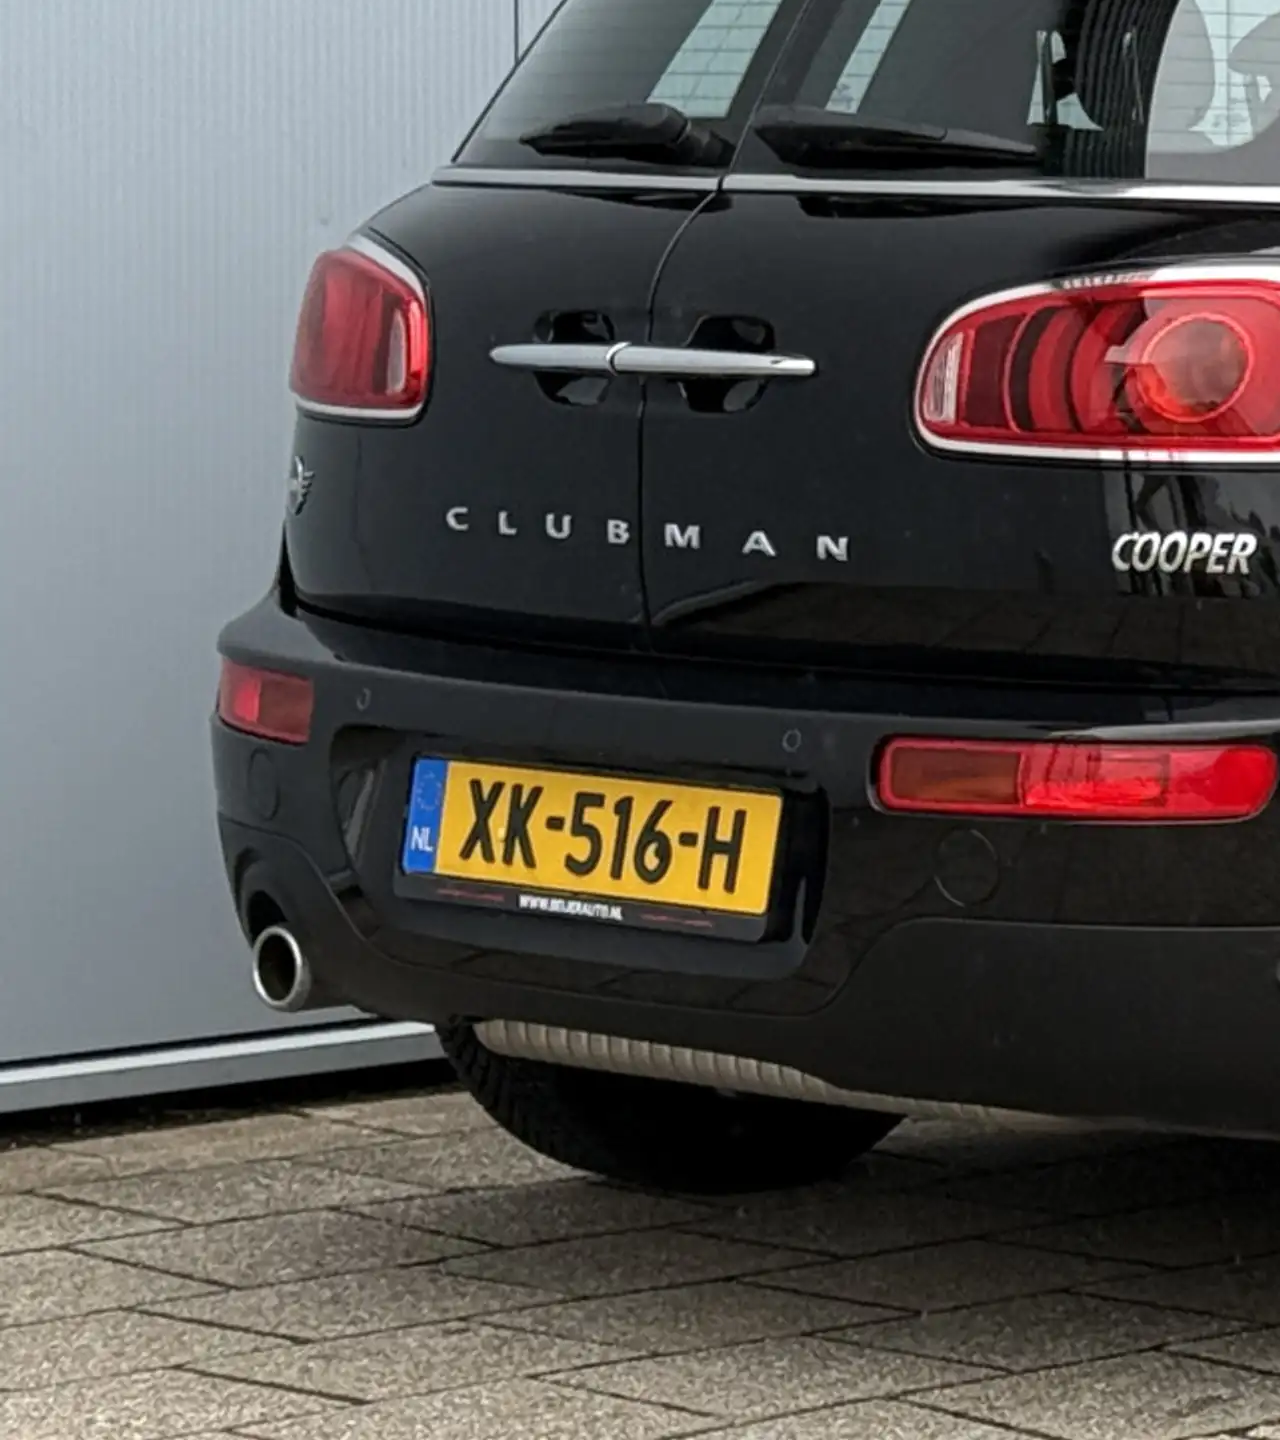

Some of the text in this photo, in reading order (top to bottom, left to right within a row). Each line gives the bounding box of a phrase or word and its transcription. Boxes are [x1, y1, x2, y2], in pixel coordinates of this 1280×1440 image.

[446, 506, 849, 561] CLUBMAN
[1112, 530, 1258, 575] COOPER
[410, 826, 433, 853] NL
[459, 778, 747, 894] XK-516-H
